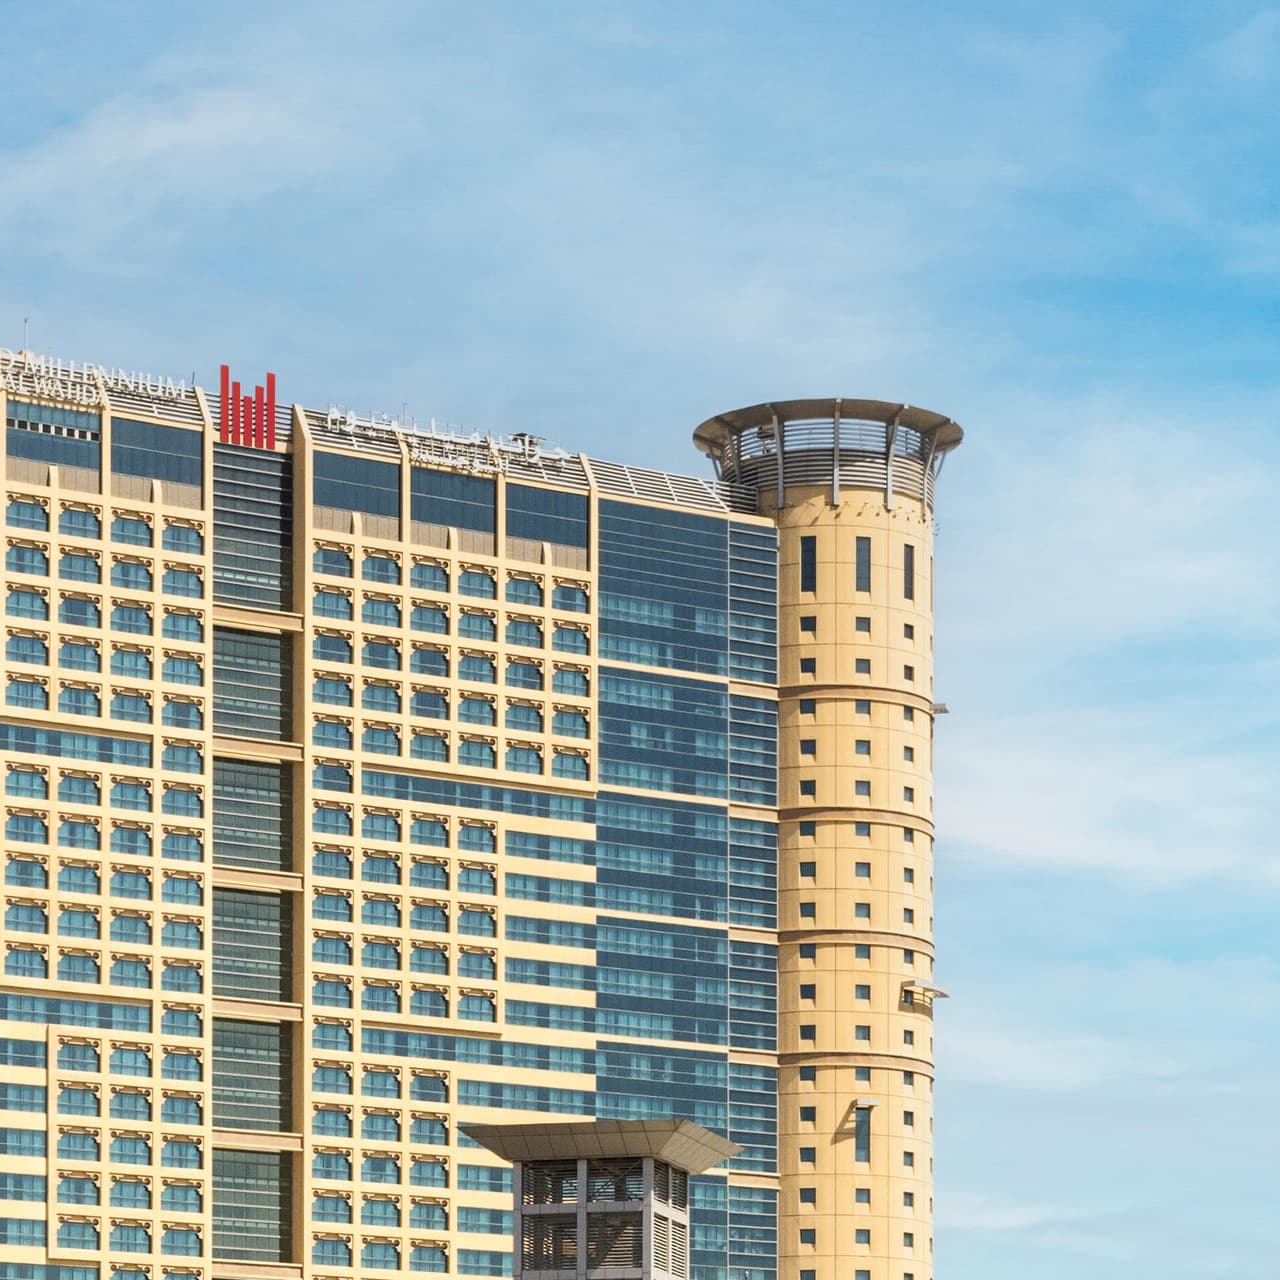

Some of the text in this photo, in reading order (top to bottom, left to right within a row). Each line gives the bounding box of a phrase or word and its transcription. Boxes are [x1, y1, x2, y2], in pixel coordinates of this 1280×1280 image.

[1, 372, 111, 406] AL WAHDA
[24, 353, 186, 401] MILLENNIUM
